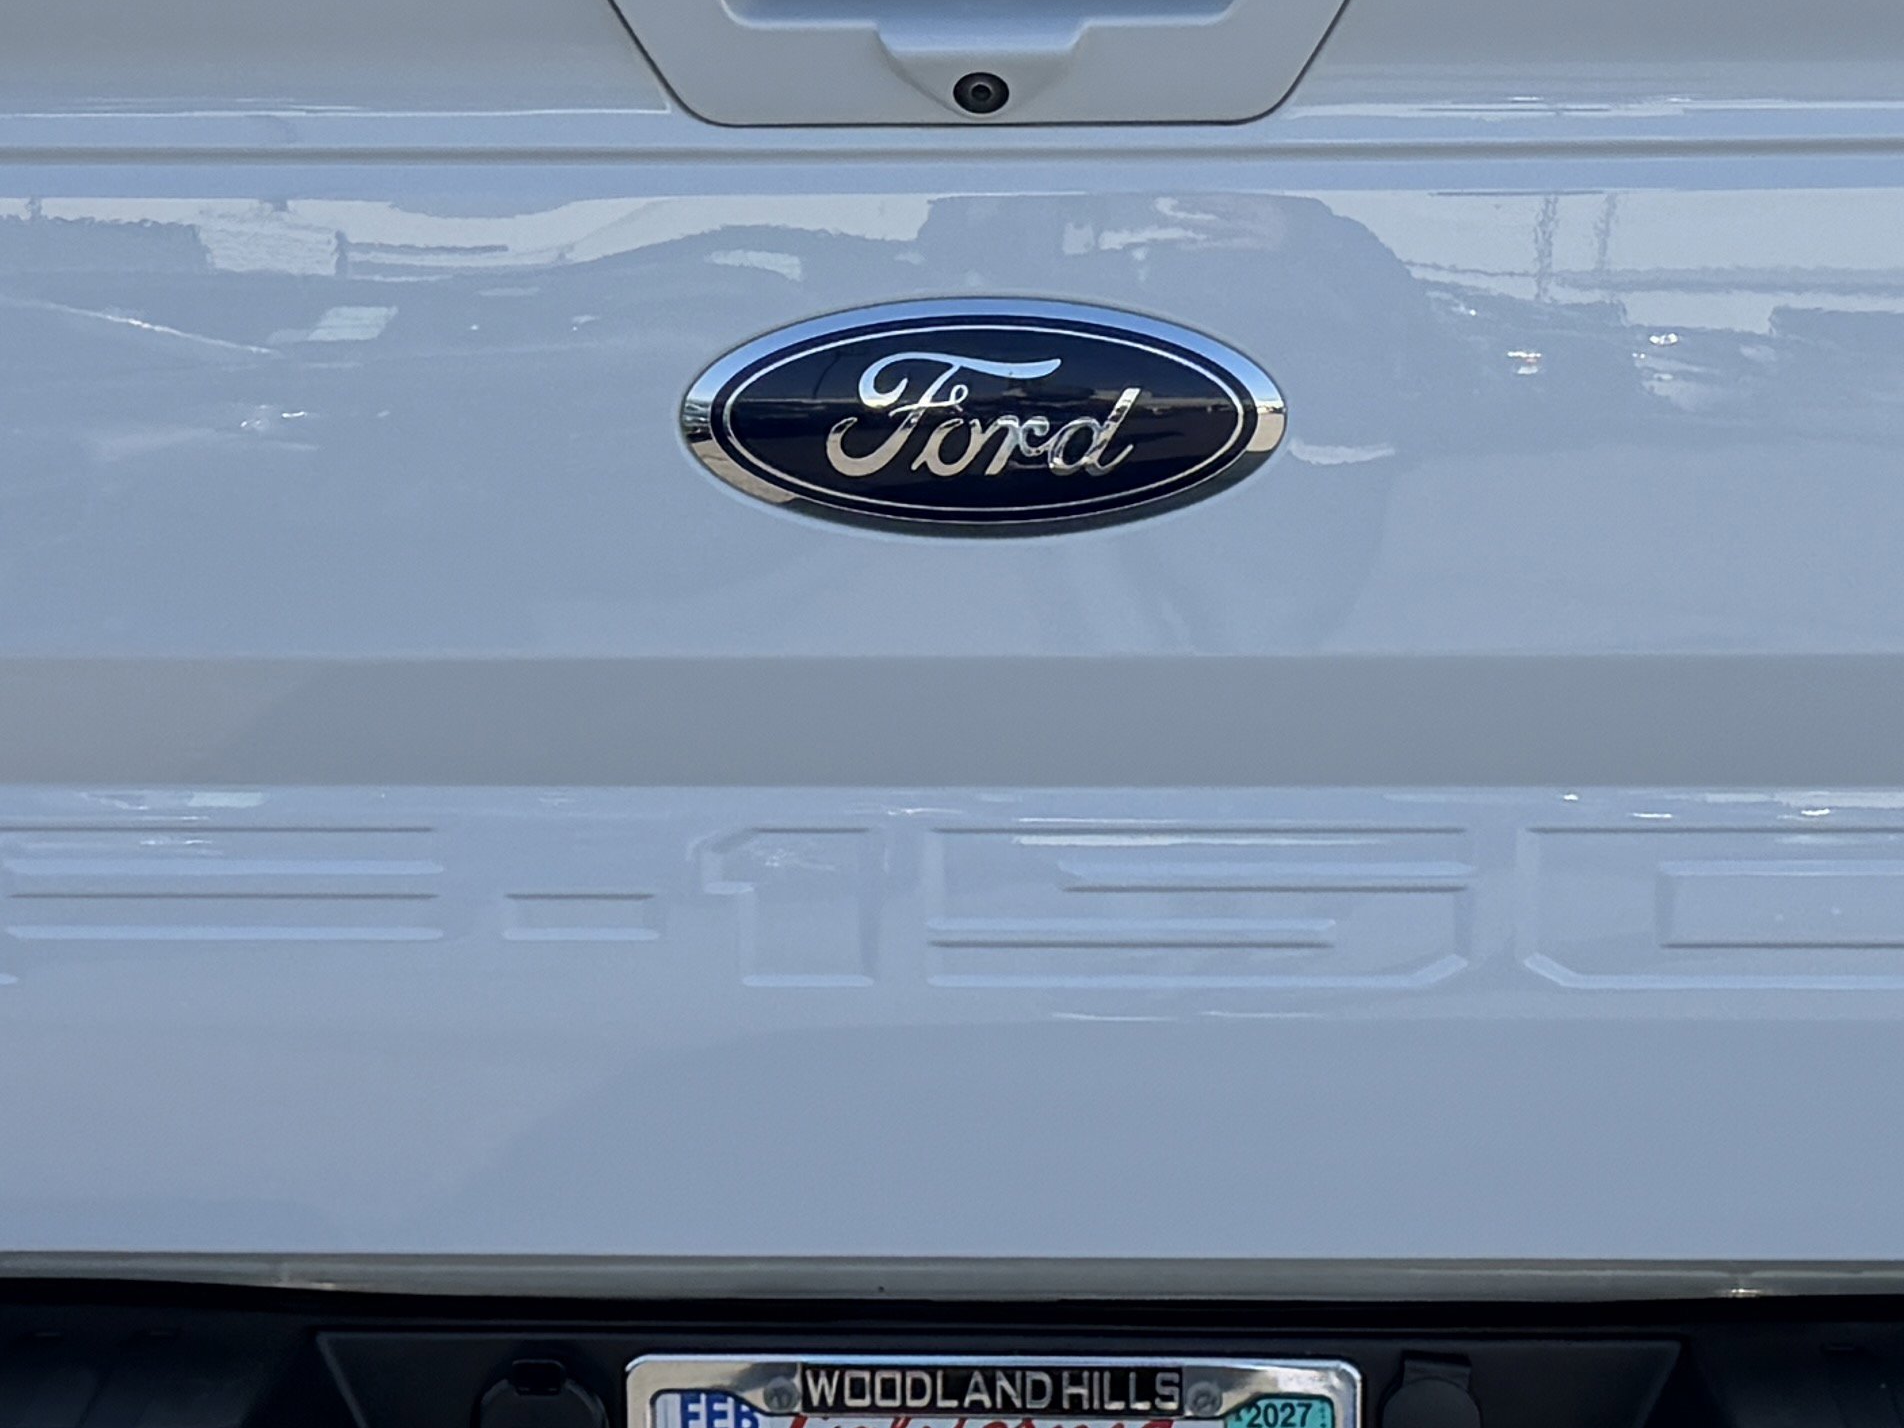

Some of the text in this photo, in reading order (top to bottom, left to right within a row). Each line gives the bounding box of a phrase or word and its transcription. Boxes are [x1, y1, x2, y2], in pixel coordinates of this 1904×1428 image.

[826, 351, 1141, 477] Ford
[805, 1369, 1180, 1410] WOODLAND HILLS
[1246, 1402, 1313, 1428] 2027
